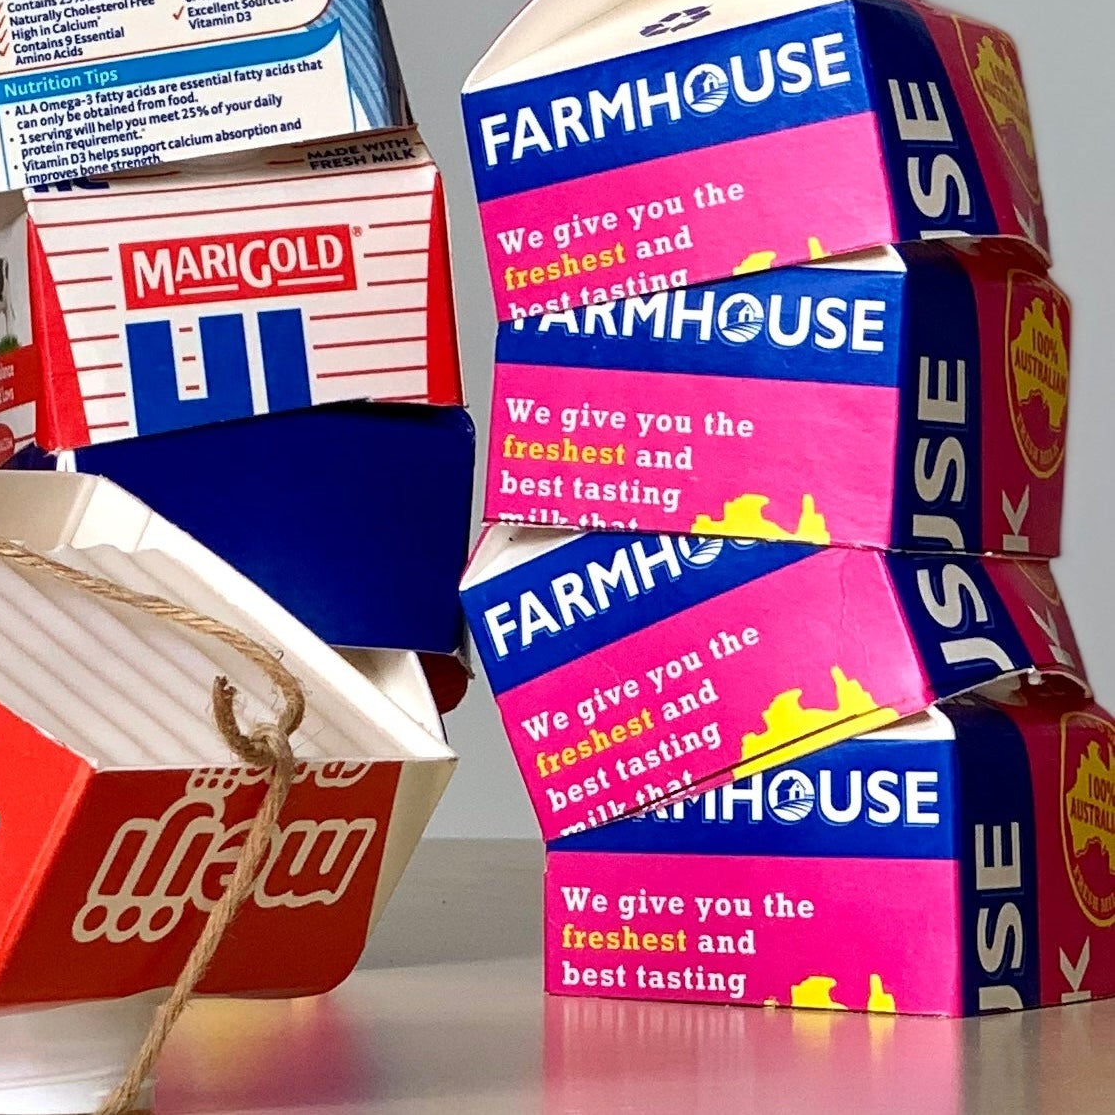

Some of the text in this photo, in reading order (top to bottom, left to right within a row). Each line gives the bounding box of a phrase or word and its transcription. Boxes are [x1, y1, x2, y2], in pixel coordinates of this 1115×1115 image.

[9, 9, 62, 26] Naturally
[187, 1, 240, 17] Excellent
[188, 10, 252, 29] Vitamin D3
[11, 25, 51, 41] High in
[13, 26, 124, 54] Contains 9 Essential
[15, 46, 83, 65] Amino Acids
[4, 69, 118, 97] Nutrition Tips
[15, 59, 323, 116] ALA Omega-3 fatty acids are essential fatty acids that
[479, 32, 851, 167] FARMHOUSE
[17, 91, 198, 130] can only be obtained from food.
[19, 94, 282, 145] 1 serving will help you meet 25% of your daily
[21, 141, 63, 159] protein
[22, 117, 301, 171] Vitamin D3 helps support calcium absorption and
[307, 137, 410, 160] MADE WITH
[310, 148, 416, 171] FRESH MILK
[497, 182, 745, 255] We give you the
[503, 225, 694, 291] freshest and
[506, 397, 754, 438] We give you the
[502, 435, 693, 471] freshest and
[499, 470, 682, 514] best tasting
[72, 794, 378, 943] meiji
[561, 887, 815, 923] We give you the
[561, 924, 756, 955] freshest and
[561, 961, 747, 999] best tasting
